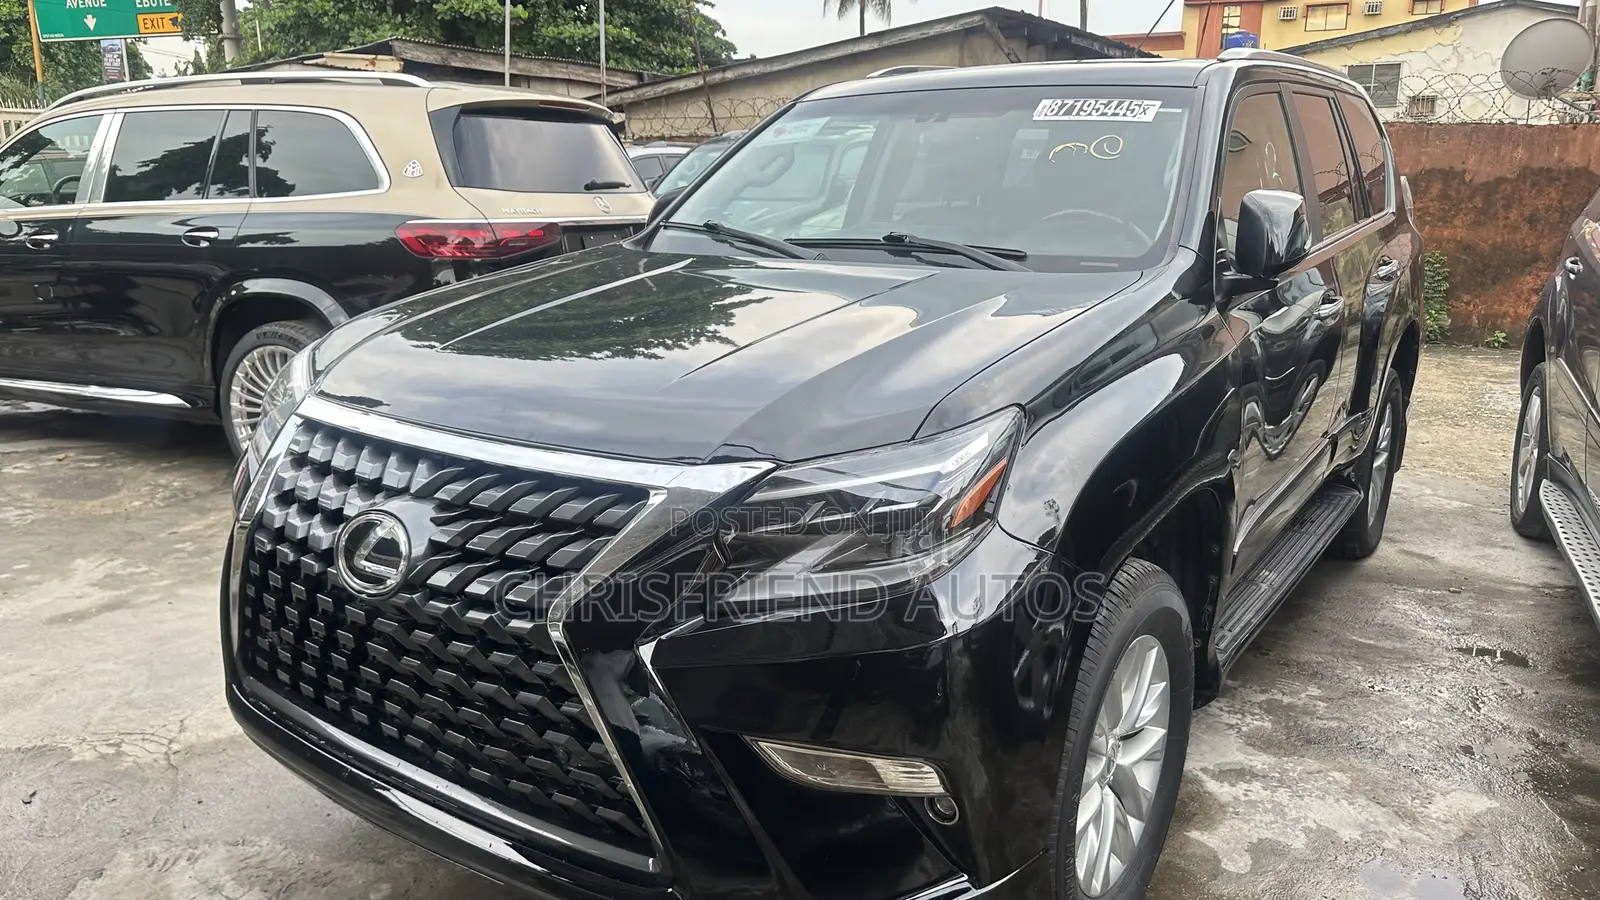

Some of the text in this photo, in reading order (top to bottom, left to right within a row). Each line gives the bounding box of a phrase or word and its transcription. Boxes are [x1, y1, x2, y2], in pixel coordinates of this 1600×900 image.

[66, 0, 107, 9] AVENUE
[135, 0, 172, 8] EBUTE
[142, 17, 166, 30] EXIT
[1044, 100, 1142, 118] 87195445
[951, 450, 972, 468] LEXUS
